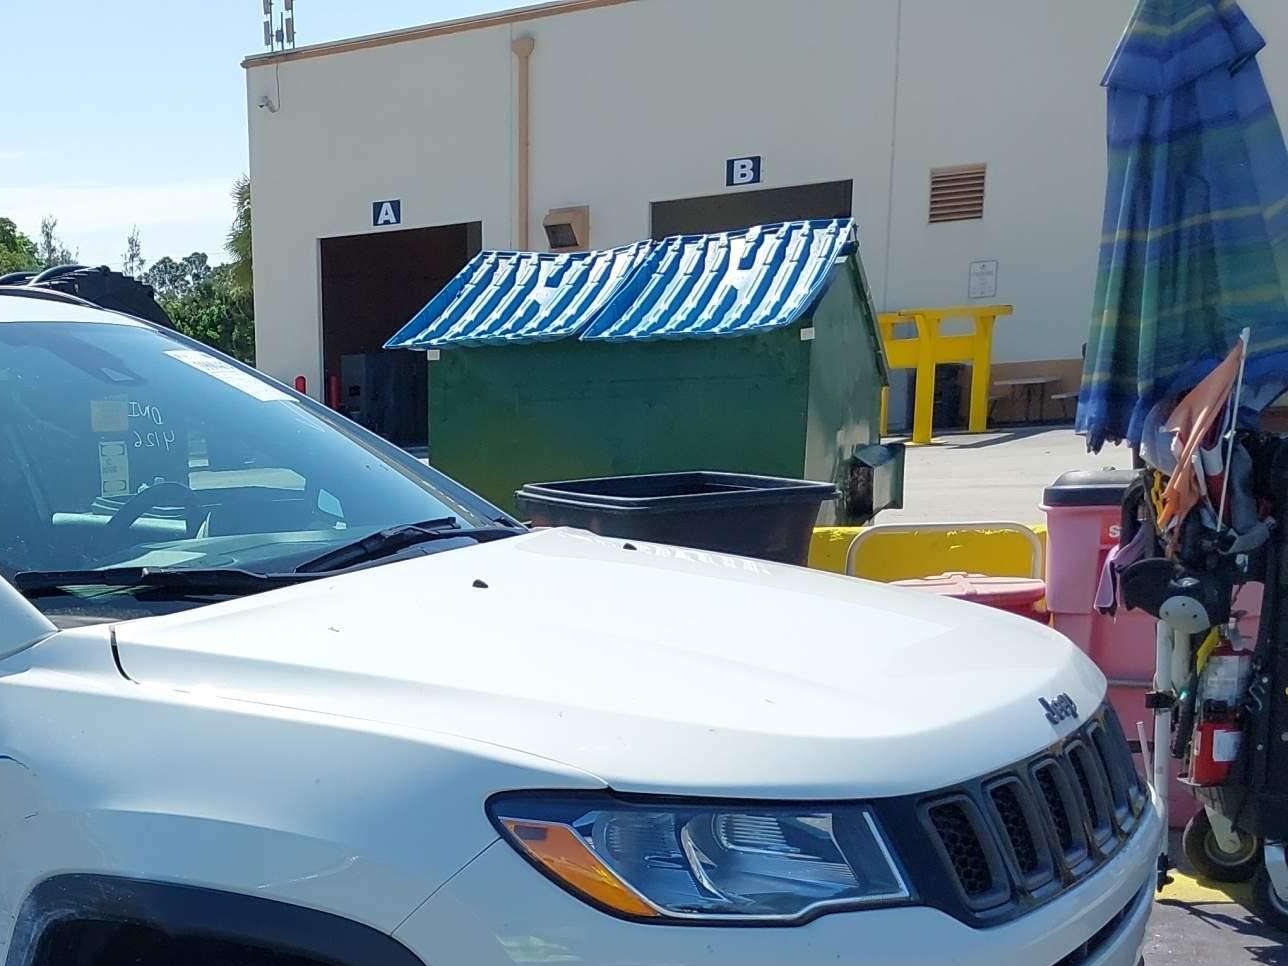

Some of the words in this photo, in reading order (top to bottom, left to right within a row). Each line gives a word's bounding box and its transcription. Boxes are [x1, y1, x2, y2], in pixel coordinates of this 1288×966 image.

[733, 158, 754, 184] B
[377, 201, 397, 225] A
[1038, 692, 1079, 725] Jeep
